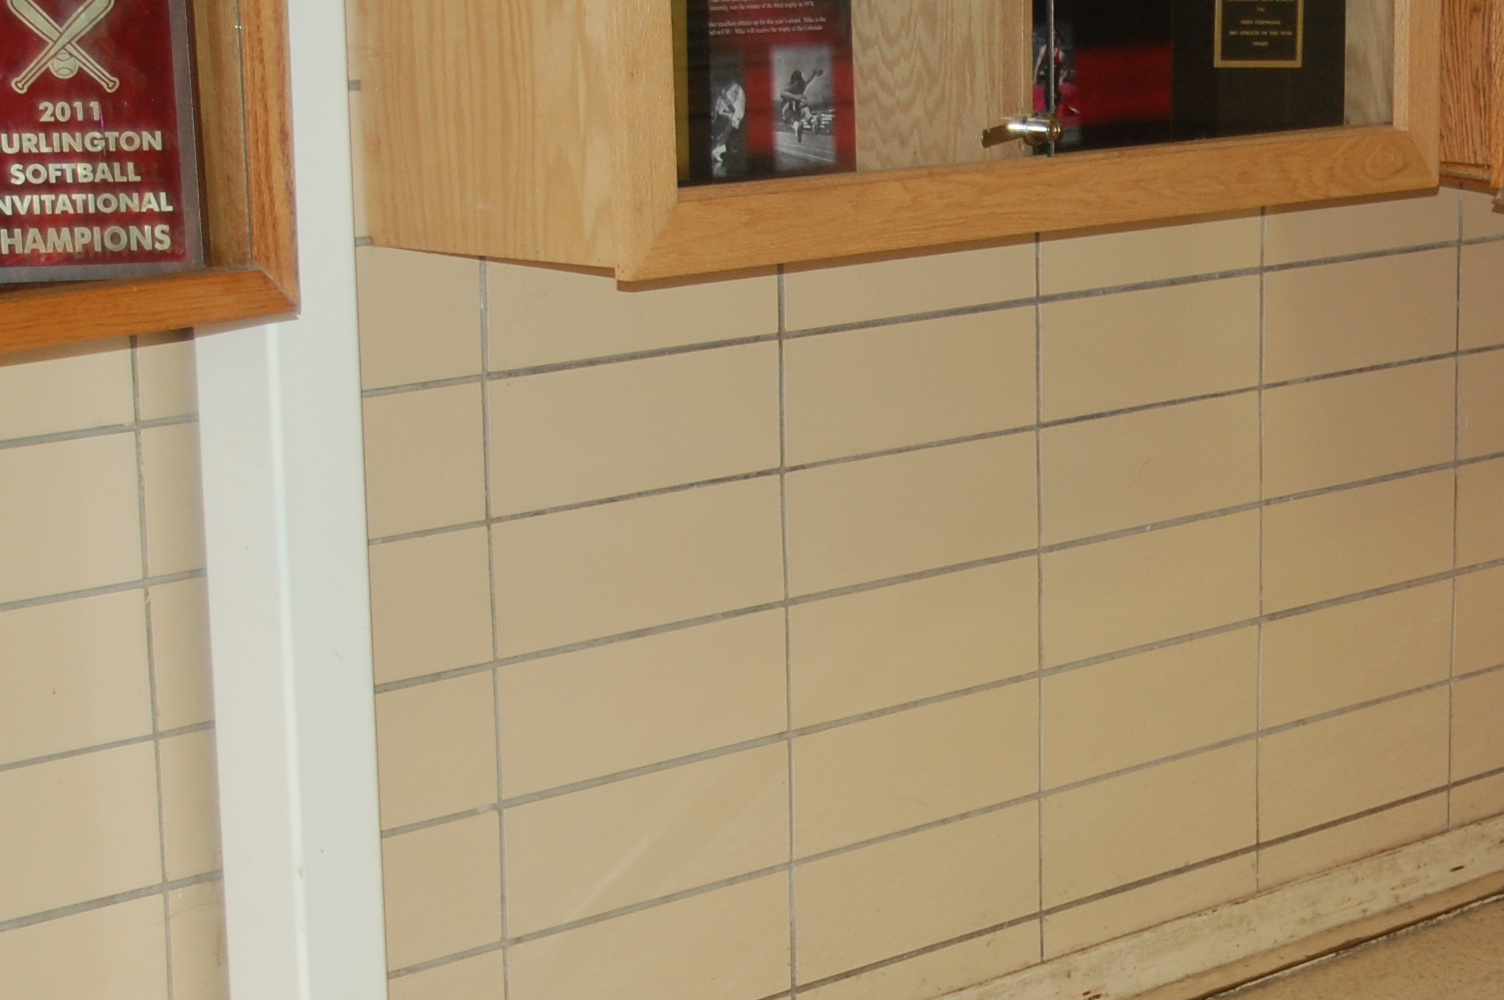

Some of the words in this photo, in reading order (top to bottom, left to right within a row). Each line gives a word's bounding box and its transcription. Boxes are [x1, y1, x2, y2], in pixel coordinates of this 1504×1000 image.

[39, 101, 101, 123] 2011
[0, 131, 163, 154] URLINGTON
[10, 162, 142, 185] SOFTBALL
[0, 191, 174, 216] NVITATIONAL
[0, 224, 172, 255] HAMPIONS
